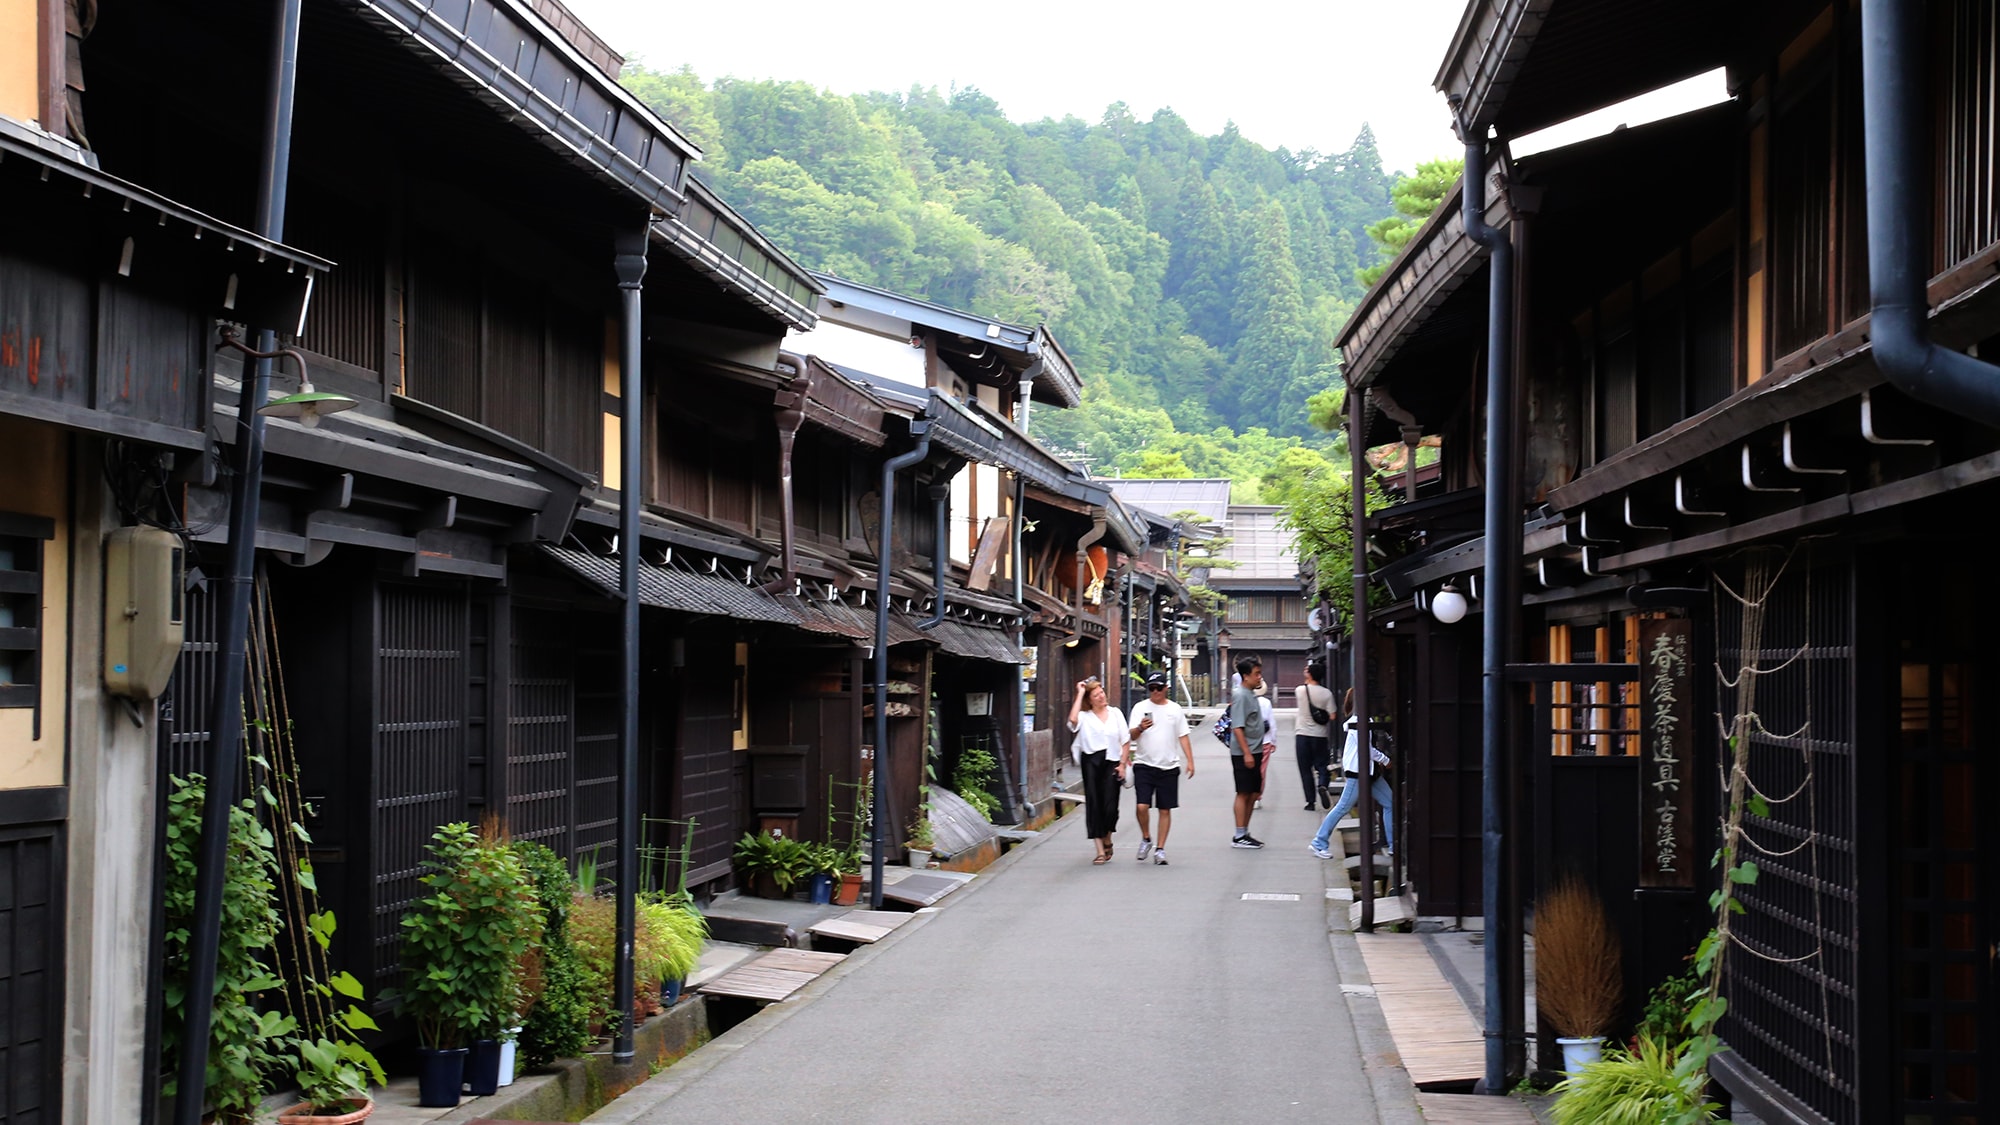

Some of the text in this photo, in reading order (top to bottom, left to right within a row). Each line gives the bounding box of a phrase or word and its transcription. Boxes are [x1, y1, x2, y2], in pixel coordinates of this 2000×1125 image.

[1650, 632, 1681, 792] 春慶茶道具
